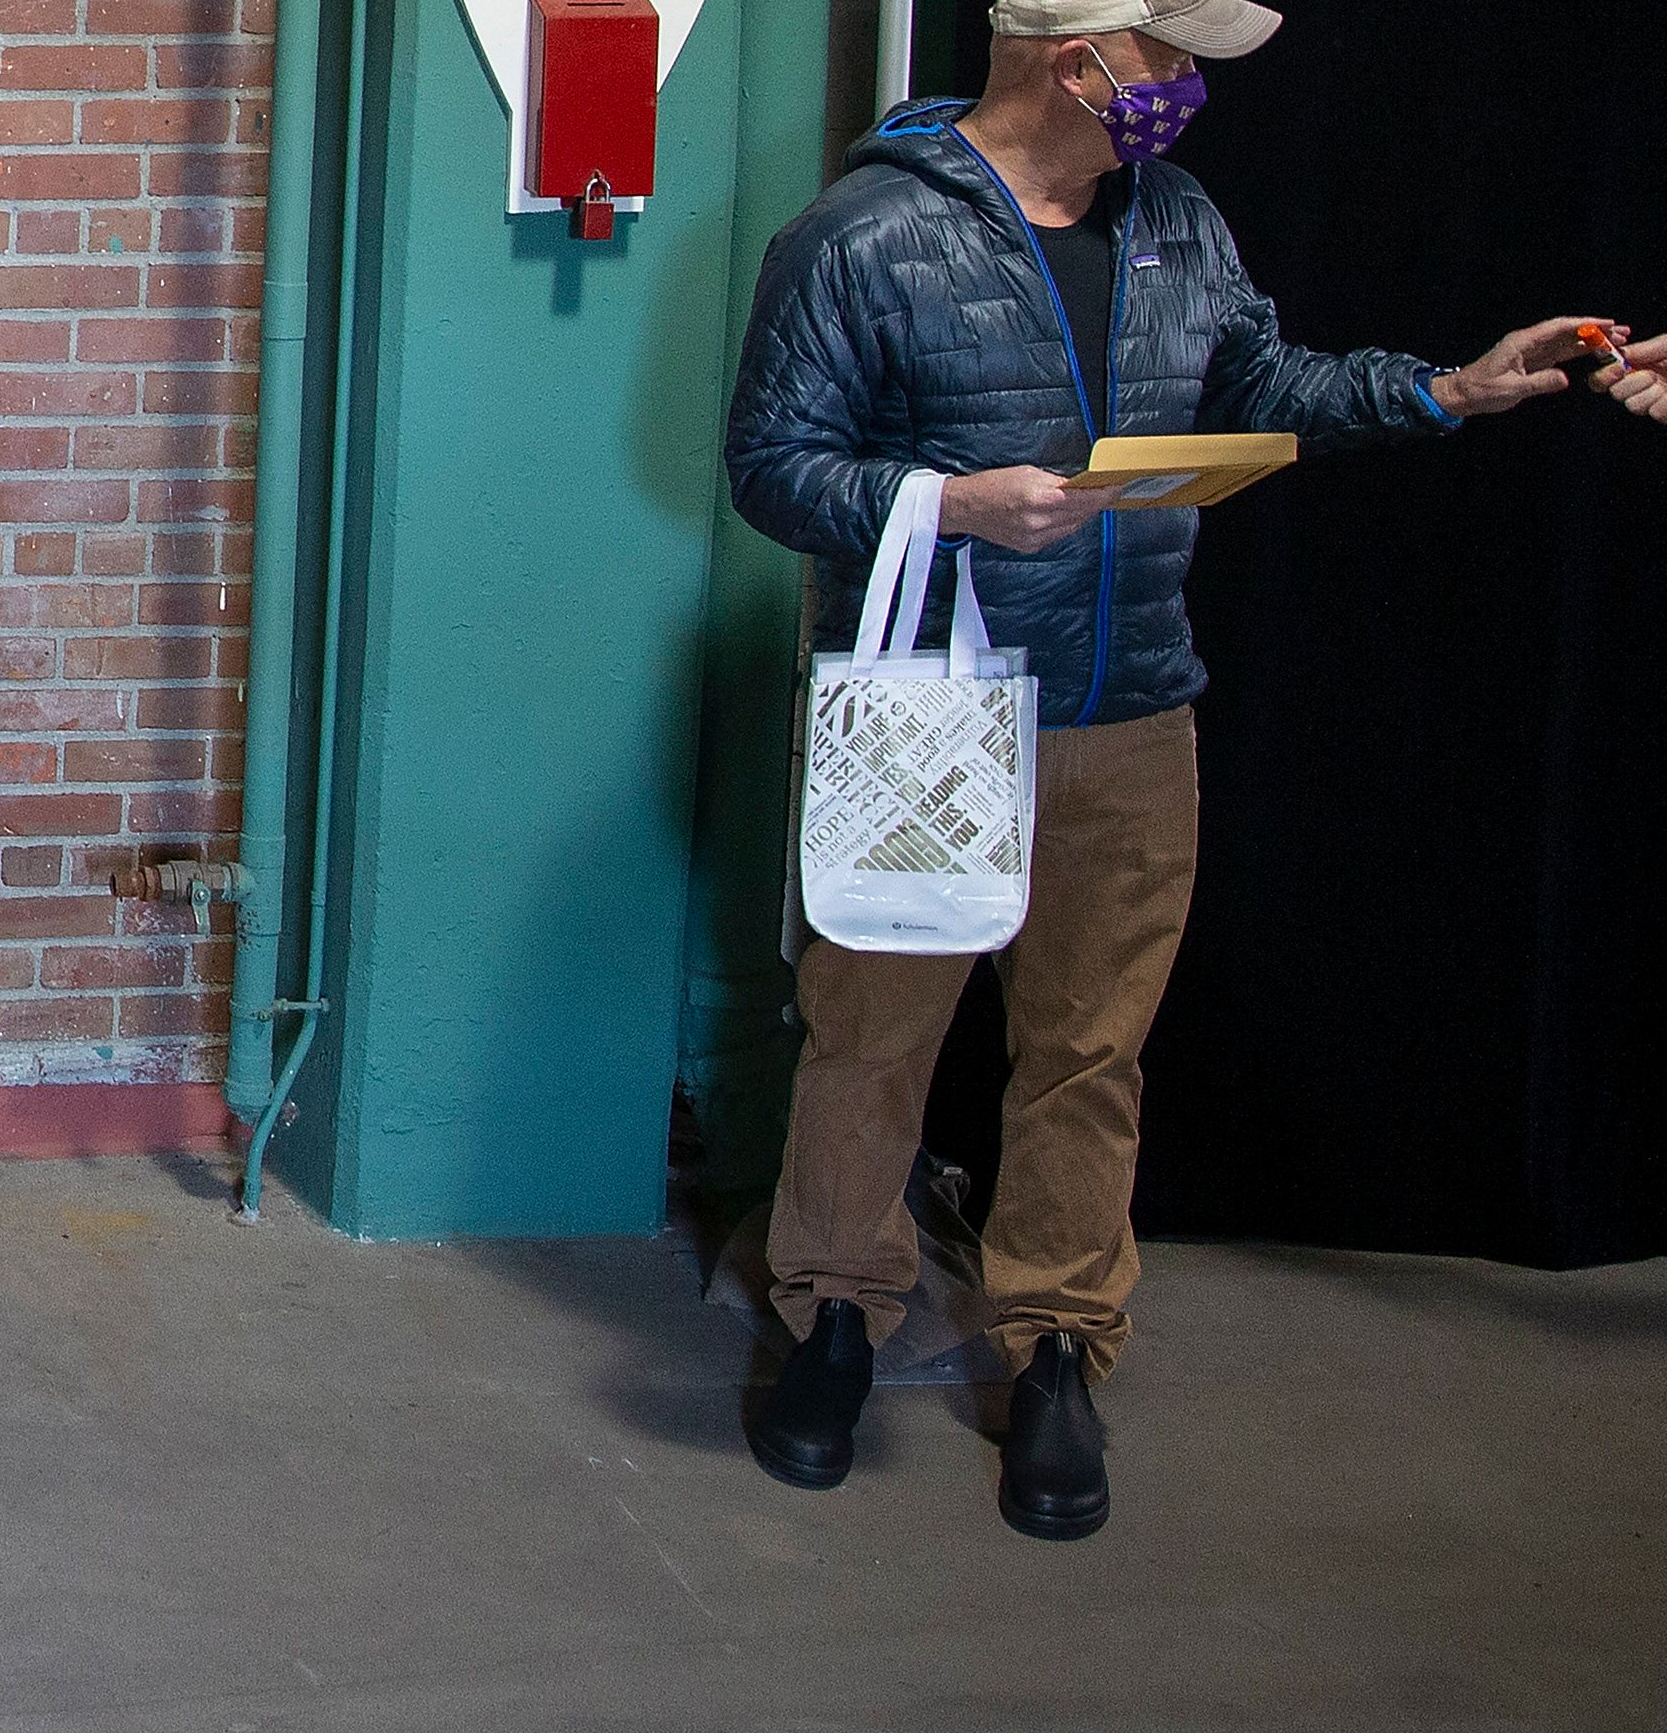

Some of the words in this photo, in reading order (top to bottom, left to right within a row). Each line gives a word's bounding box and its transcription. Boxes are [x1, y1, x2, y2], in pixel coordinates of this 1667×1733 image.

[1151, 96, 1171, 113] W
[845, 729, 875, 757] YOU
[867, 711, 891, 741] ARE
[861, 713, 928, 775] IMPORTANT.
[908, 725, 943, 764] GREAT
[917, 742, 941, 773] good
[894, 776, 927, 806] YOU
[911, 765, 970, 823] READING
[804, 806, 855, 853] HOPE
[928, 802, 968, 837] THIS.
[944, 817, 984, 853] YOU.
